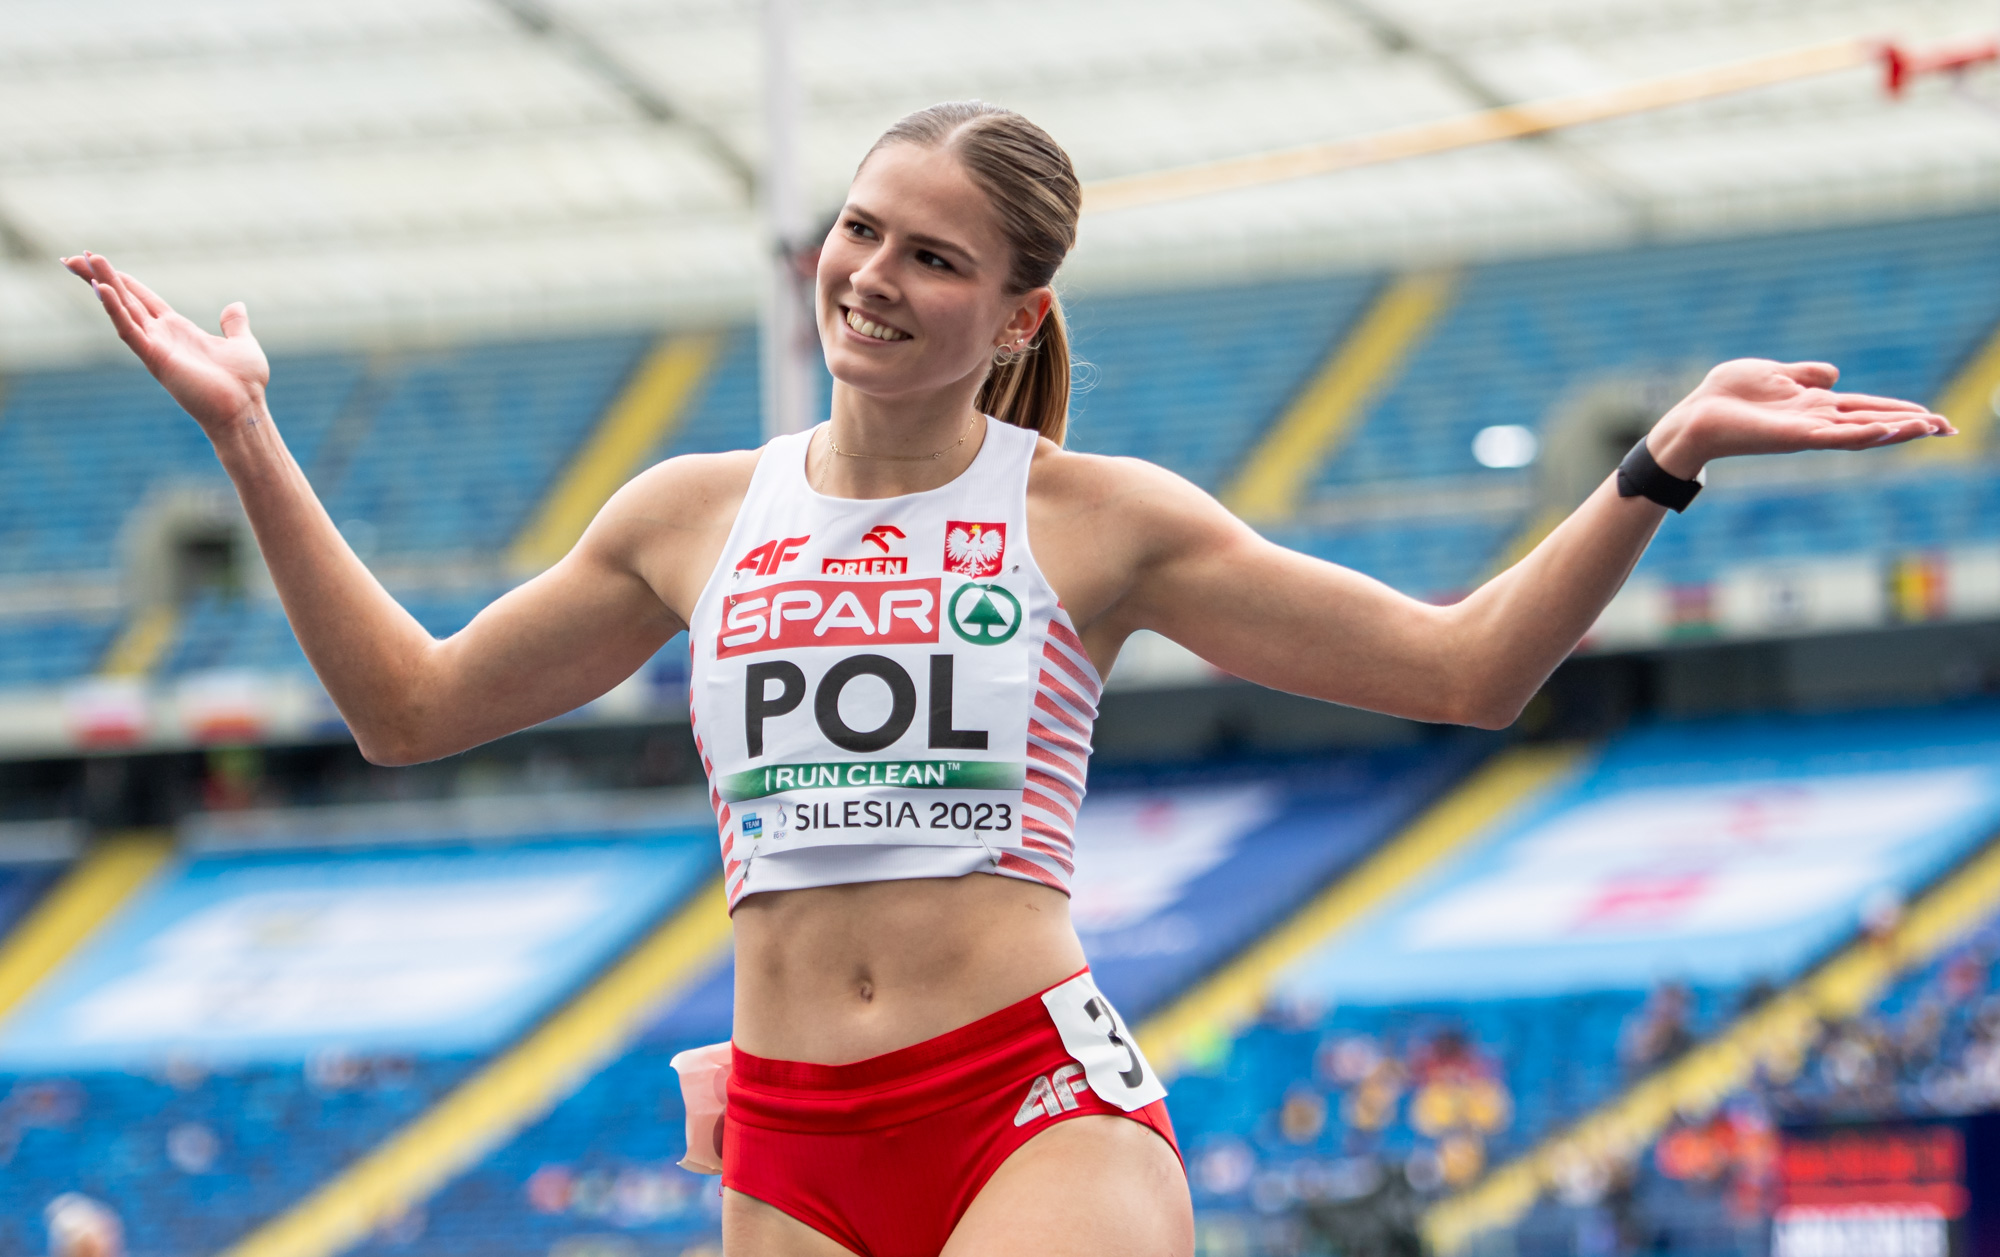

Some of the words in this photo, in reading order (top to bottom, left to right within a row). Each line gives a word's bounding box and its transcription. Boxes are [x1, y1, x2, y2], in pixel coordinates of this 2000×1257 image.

[825, 560, 902, 576] ORLEN
[722, 588, 934, 648] SPAR
[744, 653, 989, 759] POL
[764, 769, 771, 792] I
[775, 766, 840, 790] RUN
[745, 819, 761, 830] TEAM
[794, 800, 921, 832] SILESIA
[929, 802, 1013, 832] 2023
[1083, 995, 1144, 1089] 3
